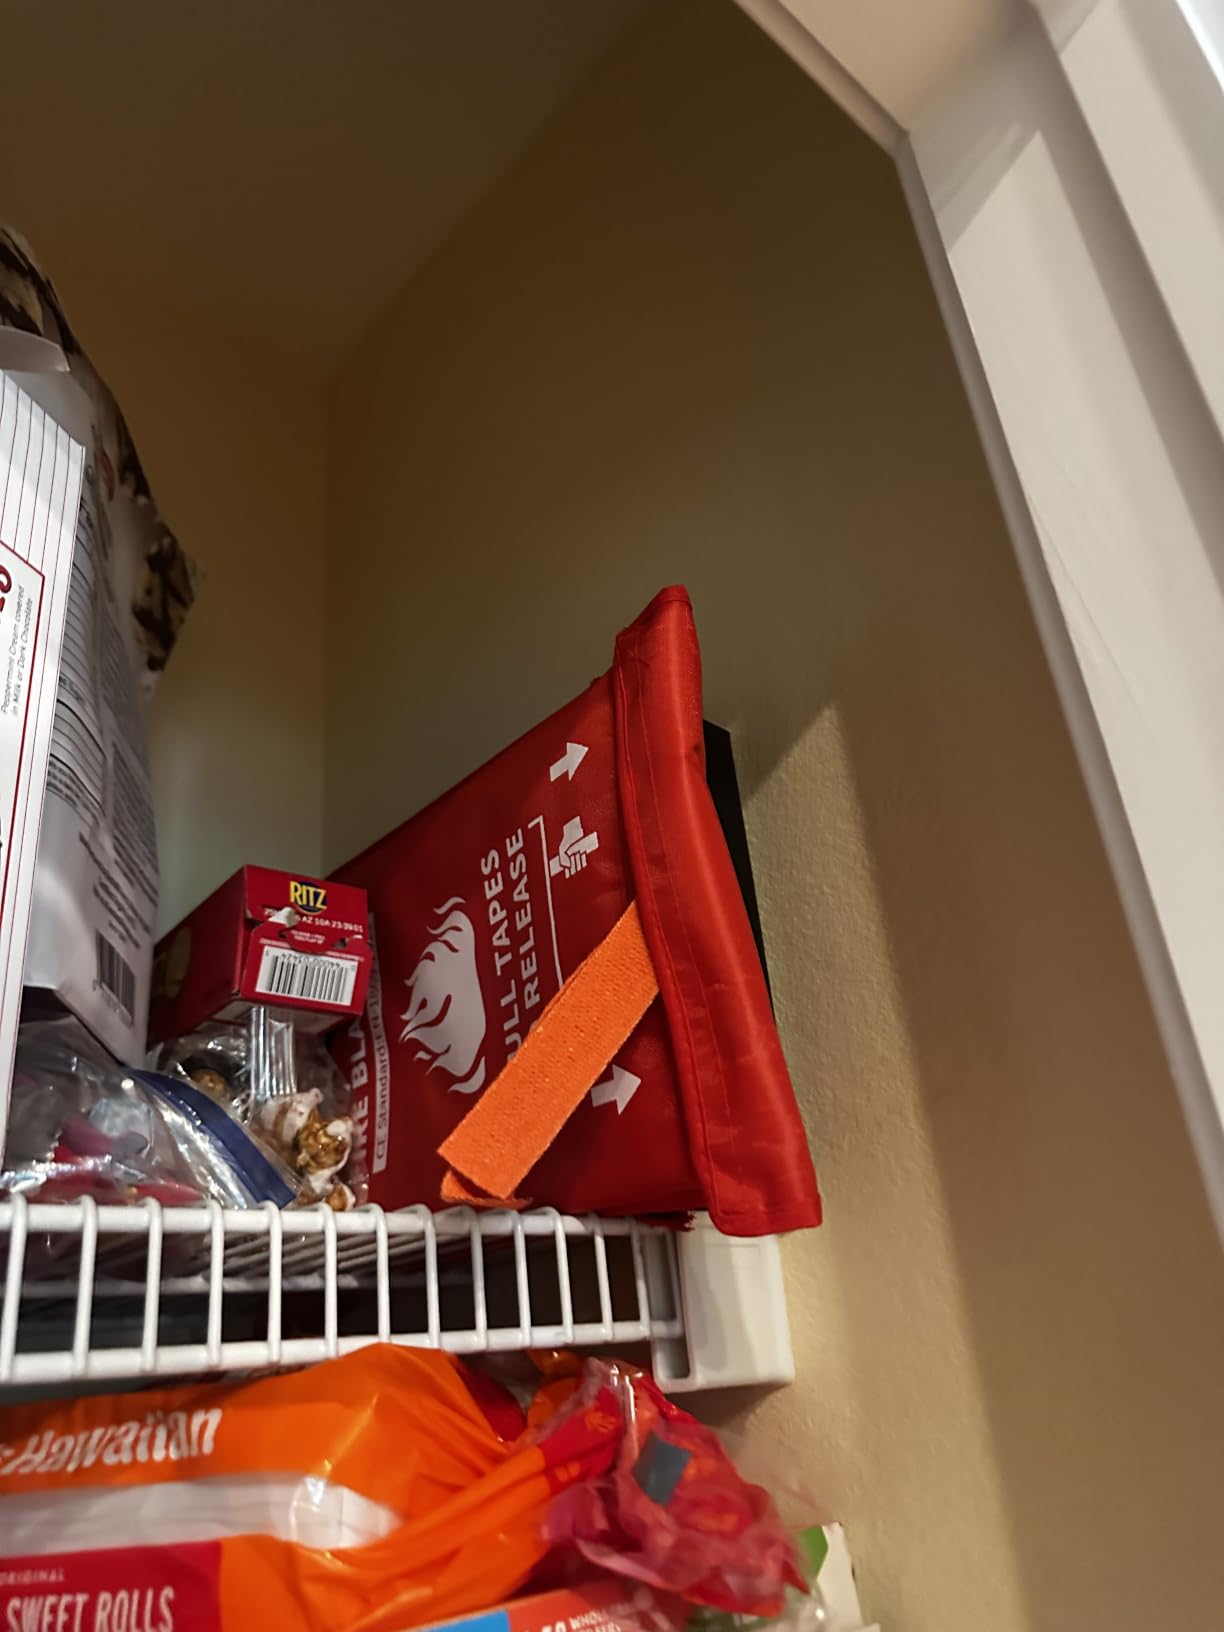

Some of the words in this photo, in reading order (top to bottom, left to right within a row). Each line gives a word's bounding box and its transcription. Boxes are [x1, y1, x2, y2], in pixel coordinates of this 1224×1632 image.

[1, 656, 15, 714] Peppermint
[9, 624, 19, 656] Cream
[15, 584, 25, 622] covered
[21, 597, 33, 644] Chocolate
[17, 645, 27, 669] Dark
[13, 683, 22, 703] Milk
[289, 881, 327, 910] RITZ
[481, 848, 513, 977] TAPES
[506, 828, 540, 1010] RELEASE
[348, 1018, 369, 1089] BLA
[502, 979, 523, 1063] ULL
[0, 1408, 223, 1475] Hawaiian
[7, 1592, 89, 1632] SWEET
[94, 1586, 175, 1632] ROLLS
